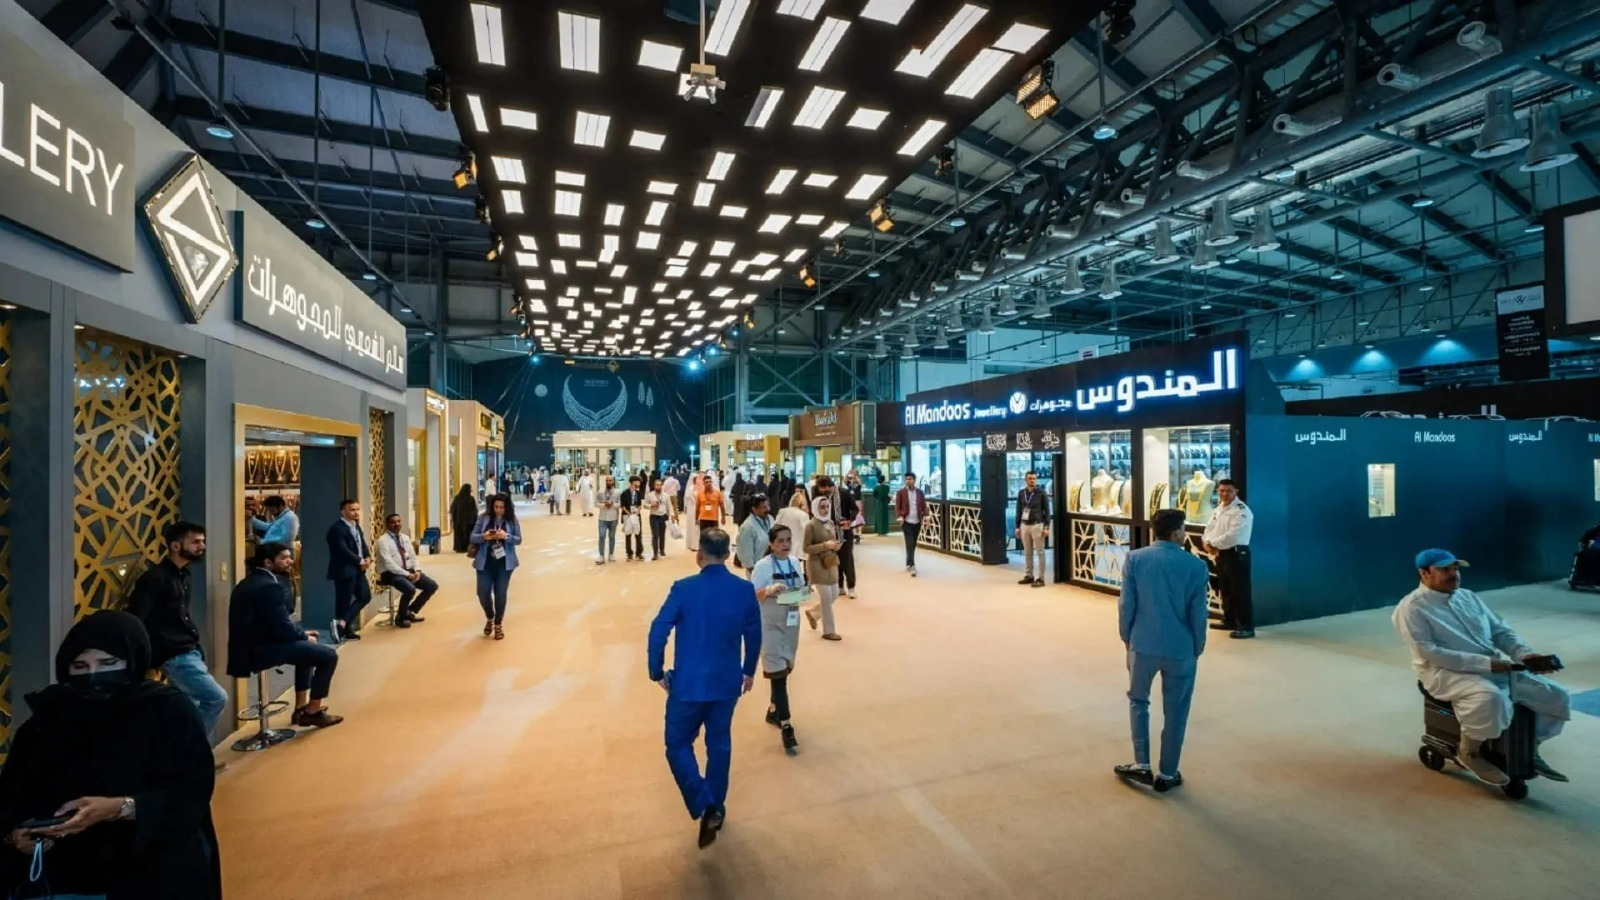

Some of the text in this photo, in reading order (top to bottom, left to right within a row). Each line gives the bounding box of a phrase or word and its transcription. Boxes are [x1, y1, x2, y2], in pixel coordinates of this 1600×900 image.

[247, 254, 342, 340] للمجوهرات
[1076, 348, 1240, 412] المندوس
[905, 399, 1008, 426] Al Mandoos Jewellery
[1295, 428, 1347, 445] المندوس
[1414, 431, 1456, 443] Al Mandoos
